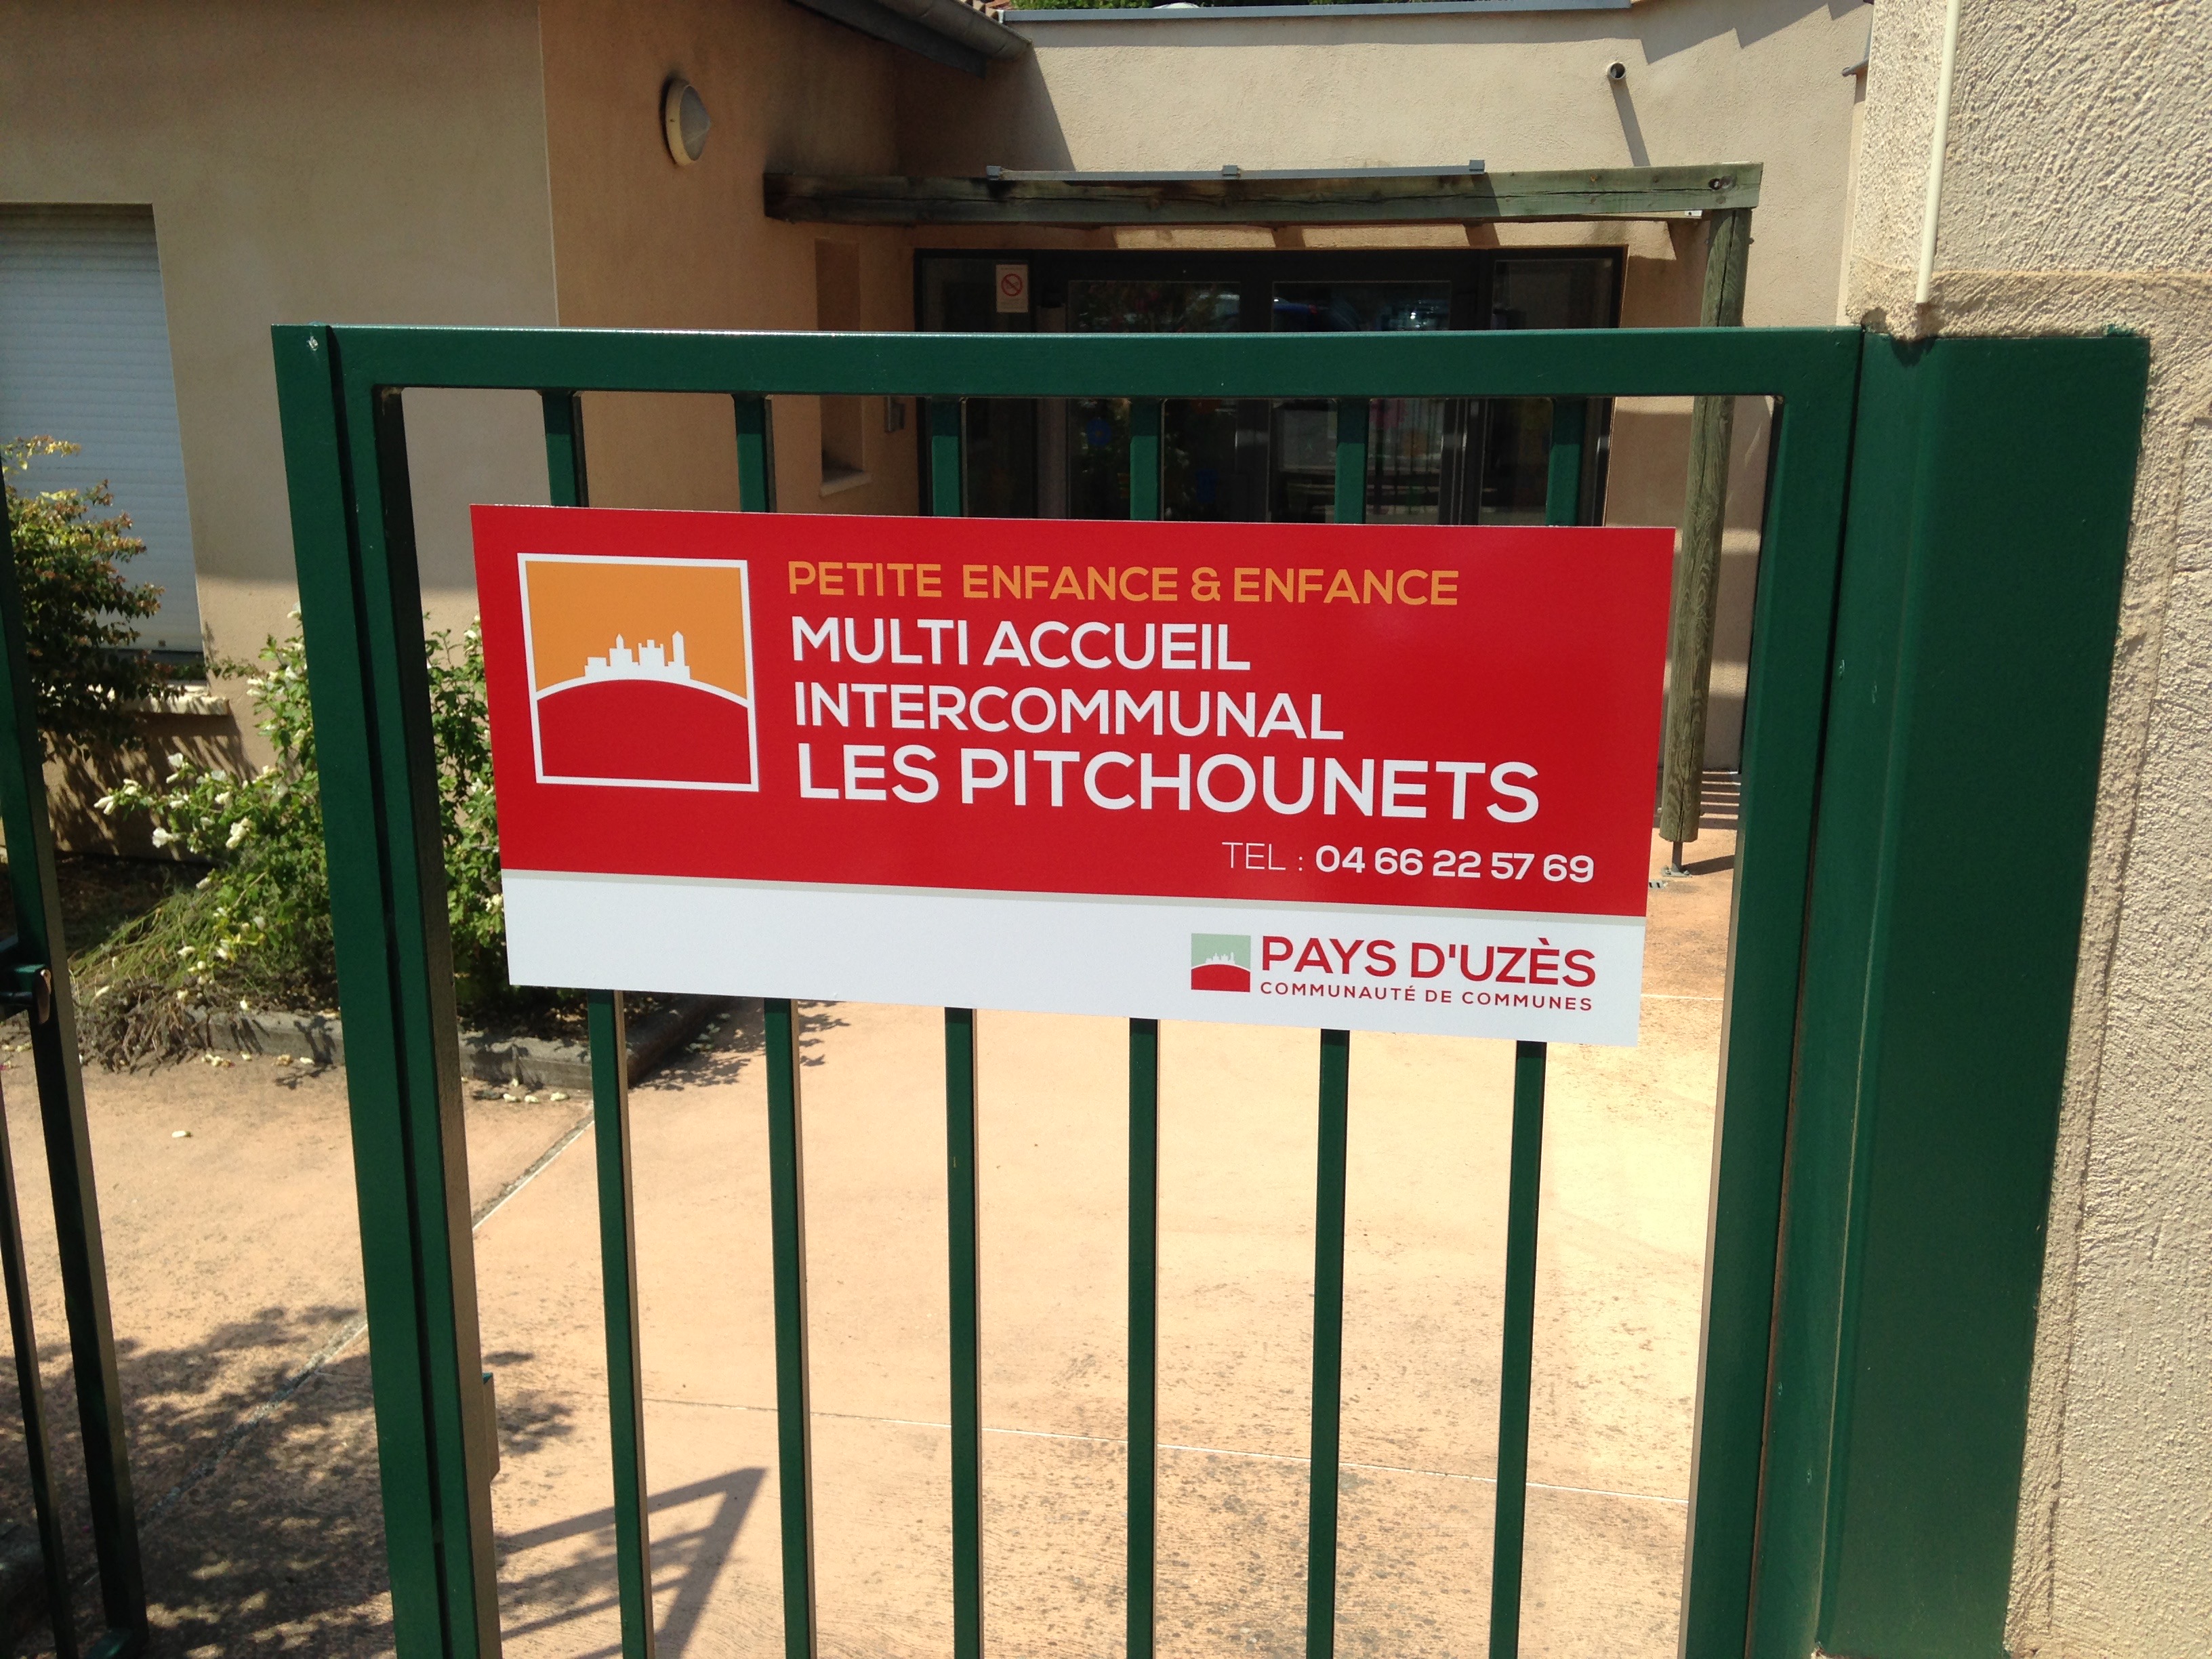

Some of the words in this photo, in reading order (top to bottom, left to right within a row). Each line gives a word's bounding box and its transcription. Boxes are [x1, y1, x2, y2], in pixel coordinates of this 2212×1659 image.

[788, 560, 942, 598] PETITE
[962, 564, 1178, 602] ENFANCE
[1191, 567, 1221, 602] &
[1233, 567, 1459, 606] ENFANCE
[792, 615, 968, 665] MULTI
[982, 620, 1251, 671] ACCUEIL
[794, 681, 1344, 740] INTERCOMMUNAL
[798, 742, 940, 804] LES
[960, 747, 1539, 823] PITCHOUNETS
[1221, 842, 1286, 871] TEL
[1315, 844, 1366, 874] 04
[1374, 847, 1423, 876] 66
[1432, 849, 1481, 878] 22
[1490, 852, 1535, 880] 57
[1542, 853, 1595, 883] 69
[1262, 935, 1397, 977] PAYS
[1410, 937, 1597, 988] D'UZÈS
[1261, 981, 1415, 1002] COMMUNAUTÉ
[1425, 989, 1452, 1004] DE
[1462, 991, 1592, 1011] COMMUNES
